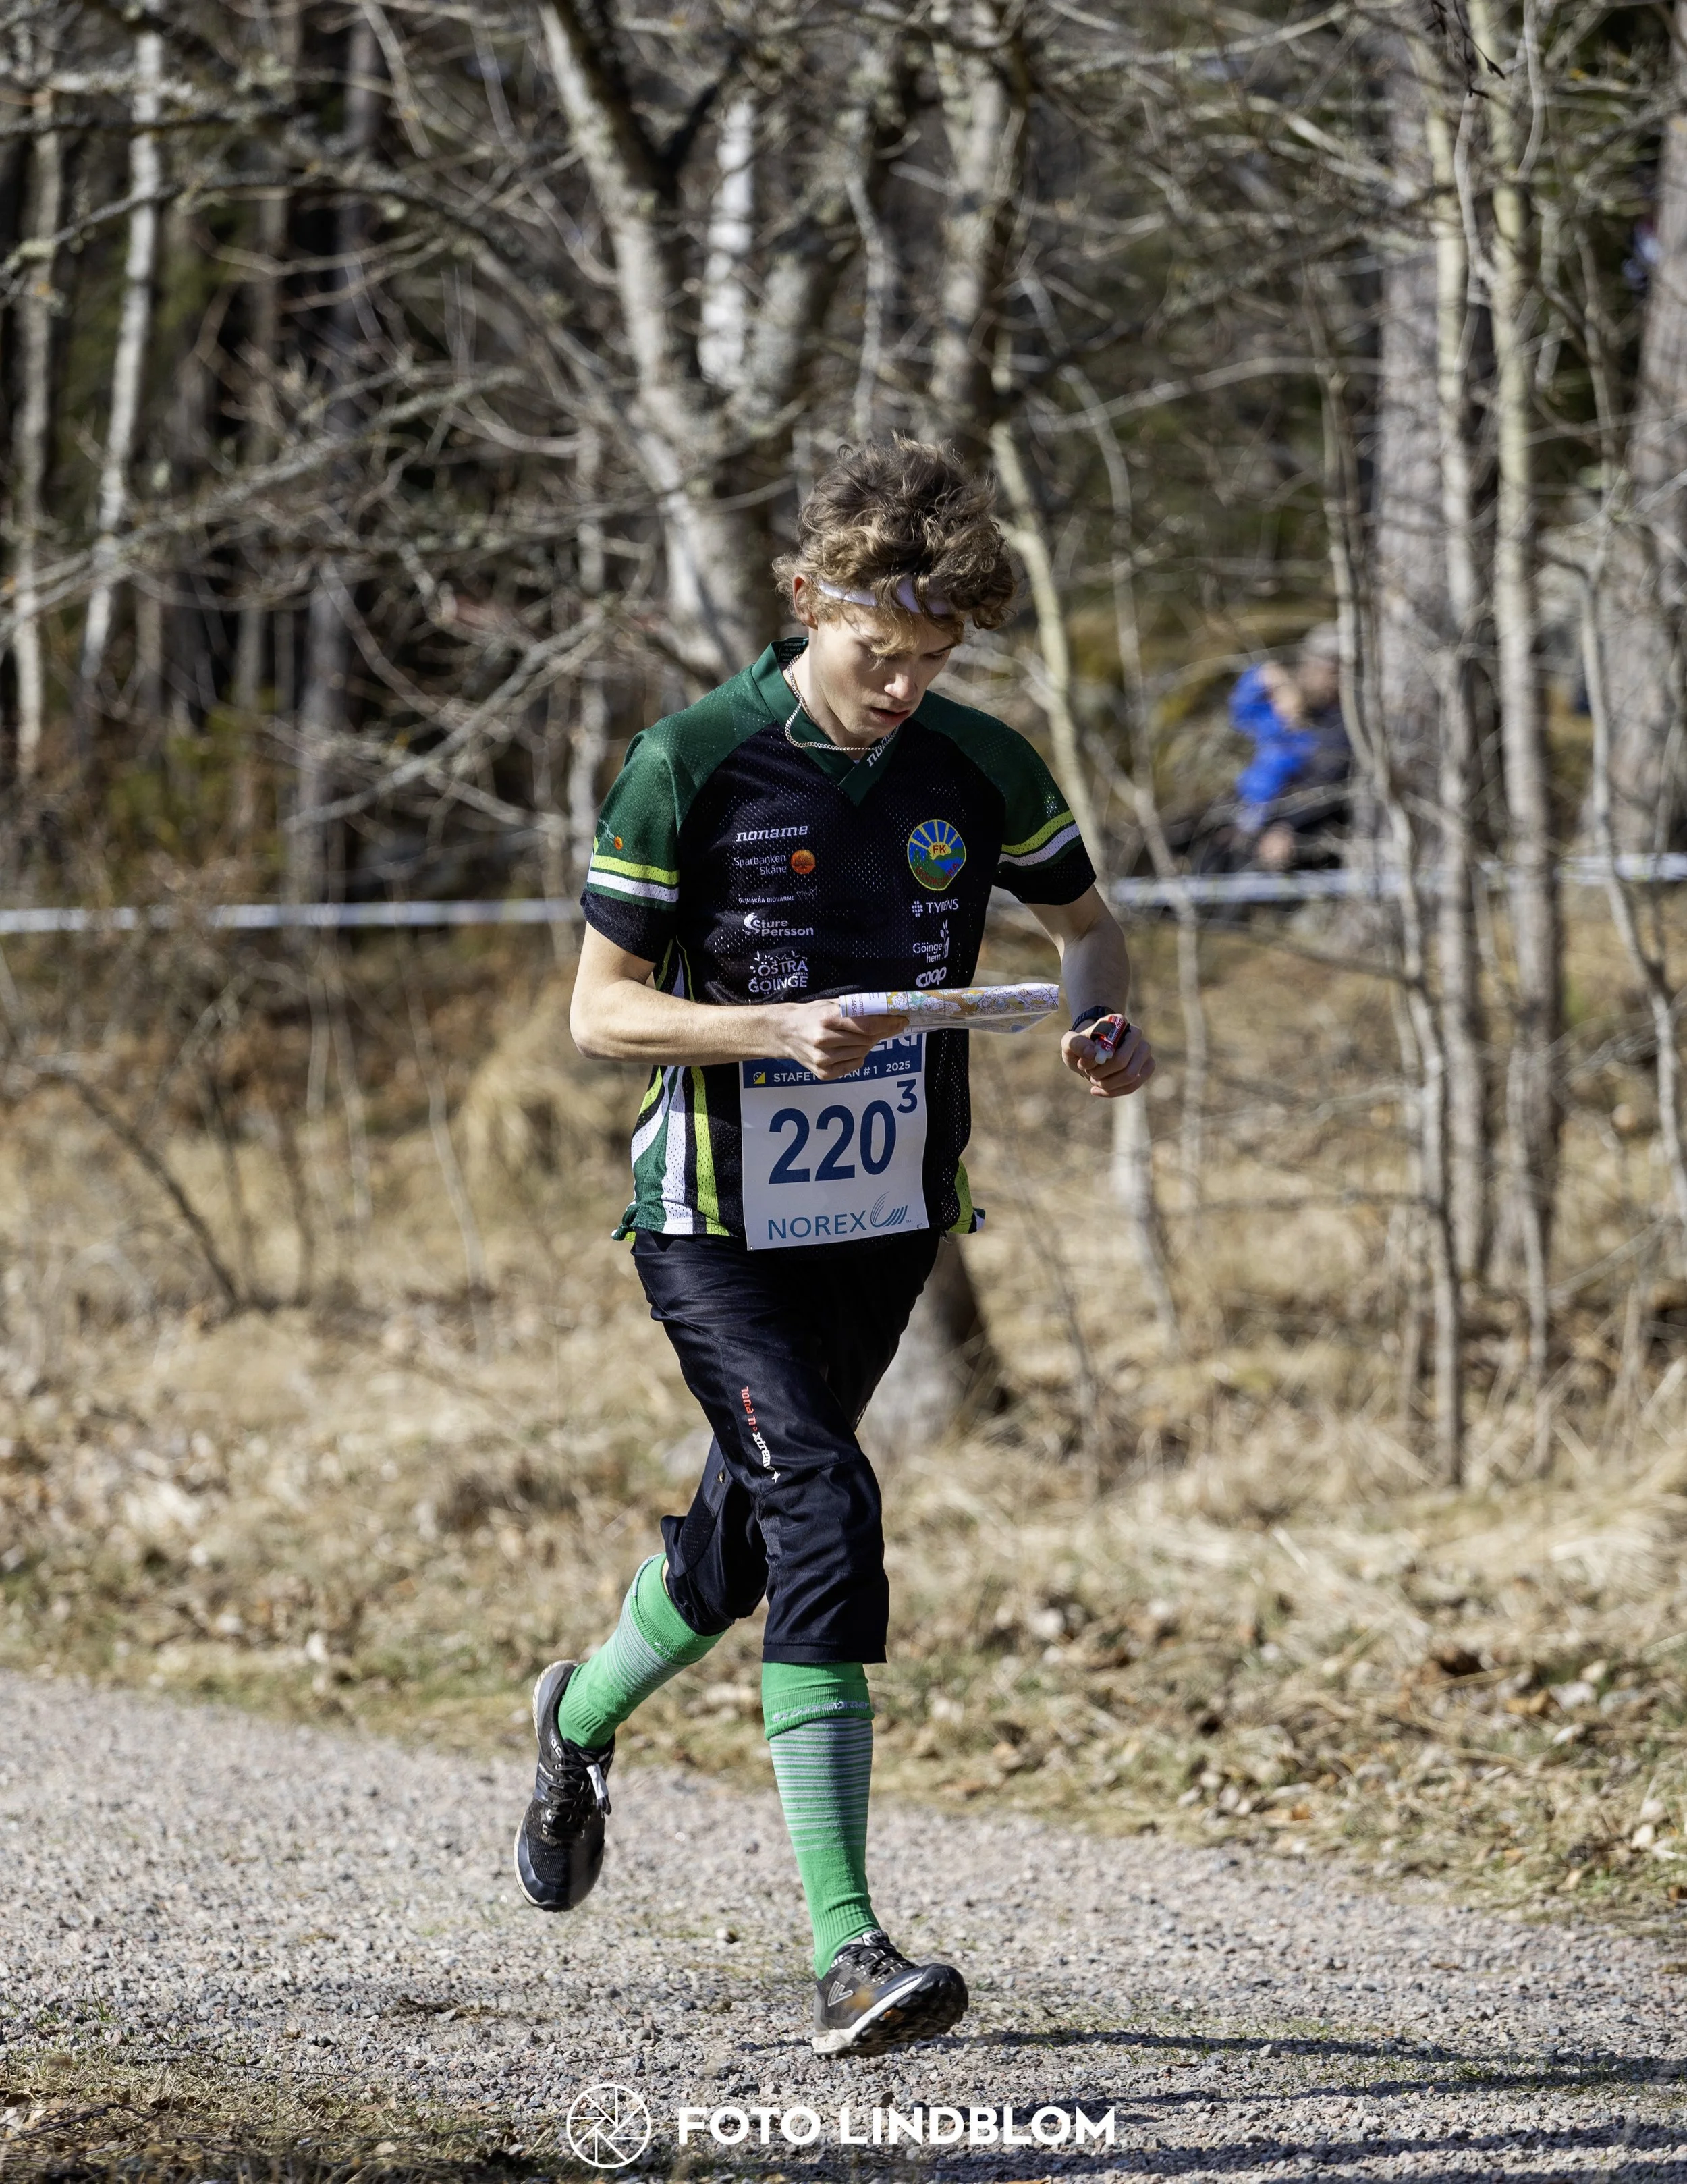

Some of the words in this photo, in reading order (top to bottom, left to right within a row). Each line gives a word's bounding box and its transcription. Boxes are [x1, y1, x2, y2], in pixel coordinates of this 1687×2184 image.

[735, 825, 808, 842] noname
[933, 844, 946, 854] FK
[734, 854, 786, 868] Sparbanken
[759, 865, 787, 875] Skåne
[912, 941, 943, 954] Göinge
[926, 952, 941, 964] hem
[758, 960, 808, 977] ÖSTRA
[916, 966, 947, 988] coop
[885, 1060, 911, 1072] 2025
[896, 1079, 918, 1114] 3
[769, 1099, 897, 1184] 220
[767, 1210, 867, 1240] NOREX
